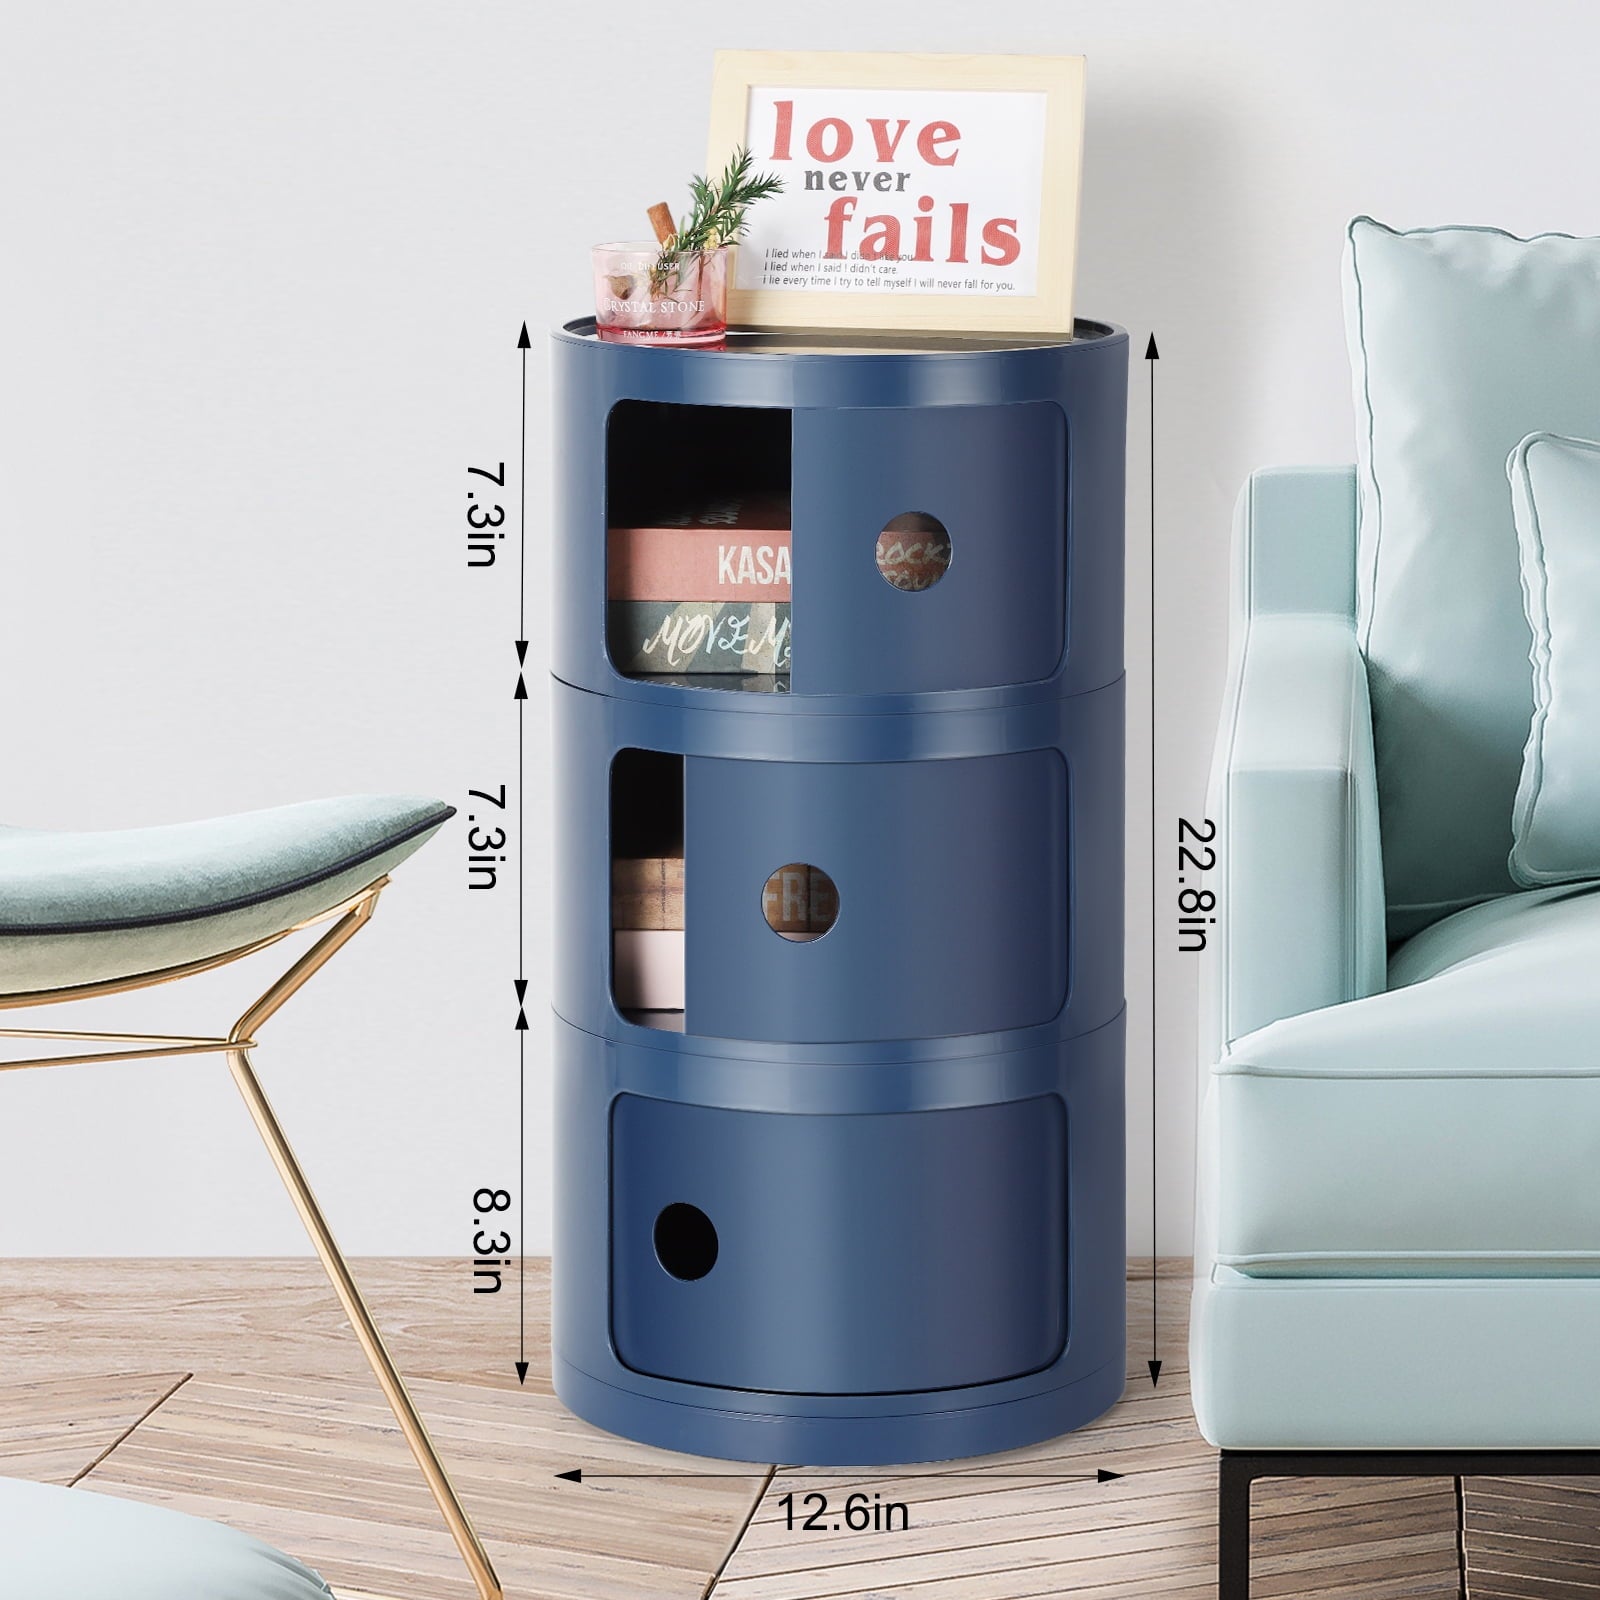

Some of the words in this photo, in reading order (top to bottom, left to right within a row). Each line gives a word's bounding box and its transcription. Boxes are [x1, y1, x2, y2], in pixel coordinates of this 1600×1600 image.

[769, 100, 961, 167] love
[804, 170, 911, 192] never
[823, 195, 1021, 266] fails
[771, 249, 789, 259] lied
[792, 249, 816, 259] when
[770, 262, 788, 272] lied
[790, 262, 815, 272] when
[823, 263, 841, 273] said
[850, 264, 876, 274] didn't
[769, 275, 780, 285] lie
[783, 276, 808, 287] every
[811, 275, 831, 286] time
[839, 276, 852, 288] try
[854, 276, 864, 287] to
[866, 276, 881, 287] tell
[883, 277, 911, 290] myself
[919, 279, 935, 289] will
[937, 279, 962, 289] never
[964, 279, 978, 290] fall
[980, 280, 993, 290] for
[995, 281, 1016, 292] you.
[602, 298, 656, 313] CRYSTAL
[660, 301, 705, 312] STONE
[718, 545, 791, 585] KASA
